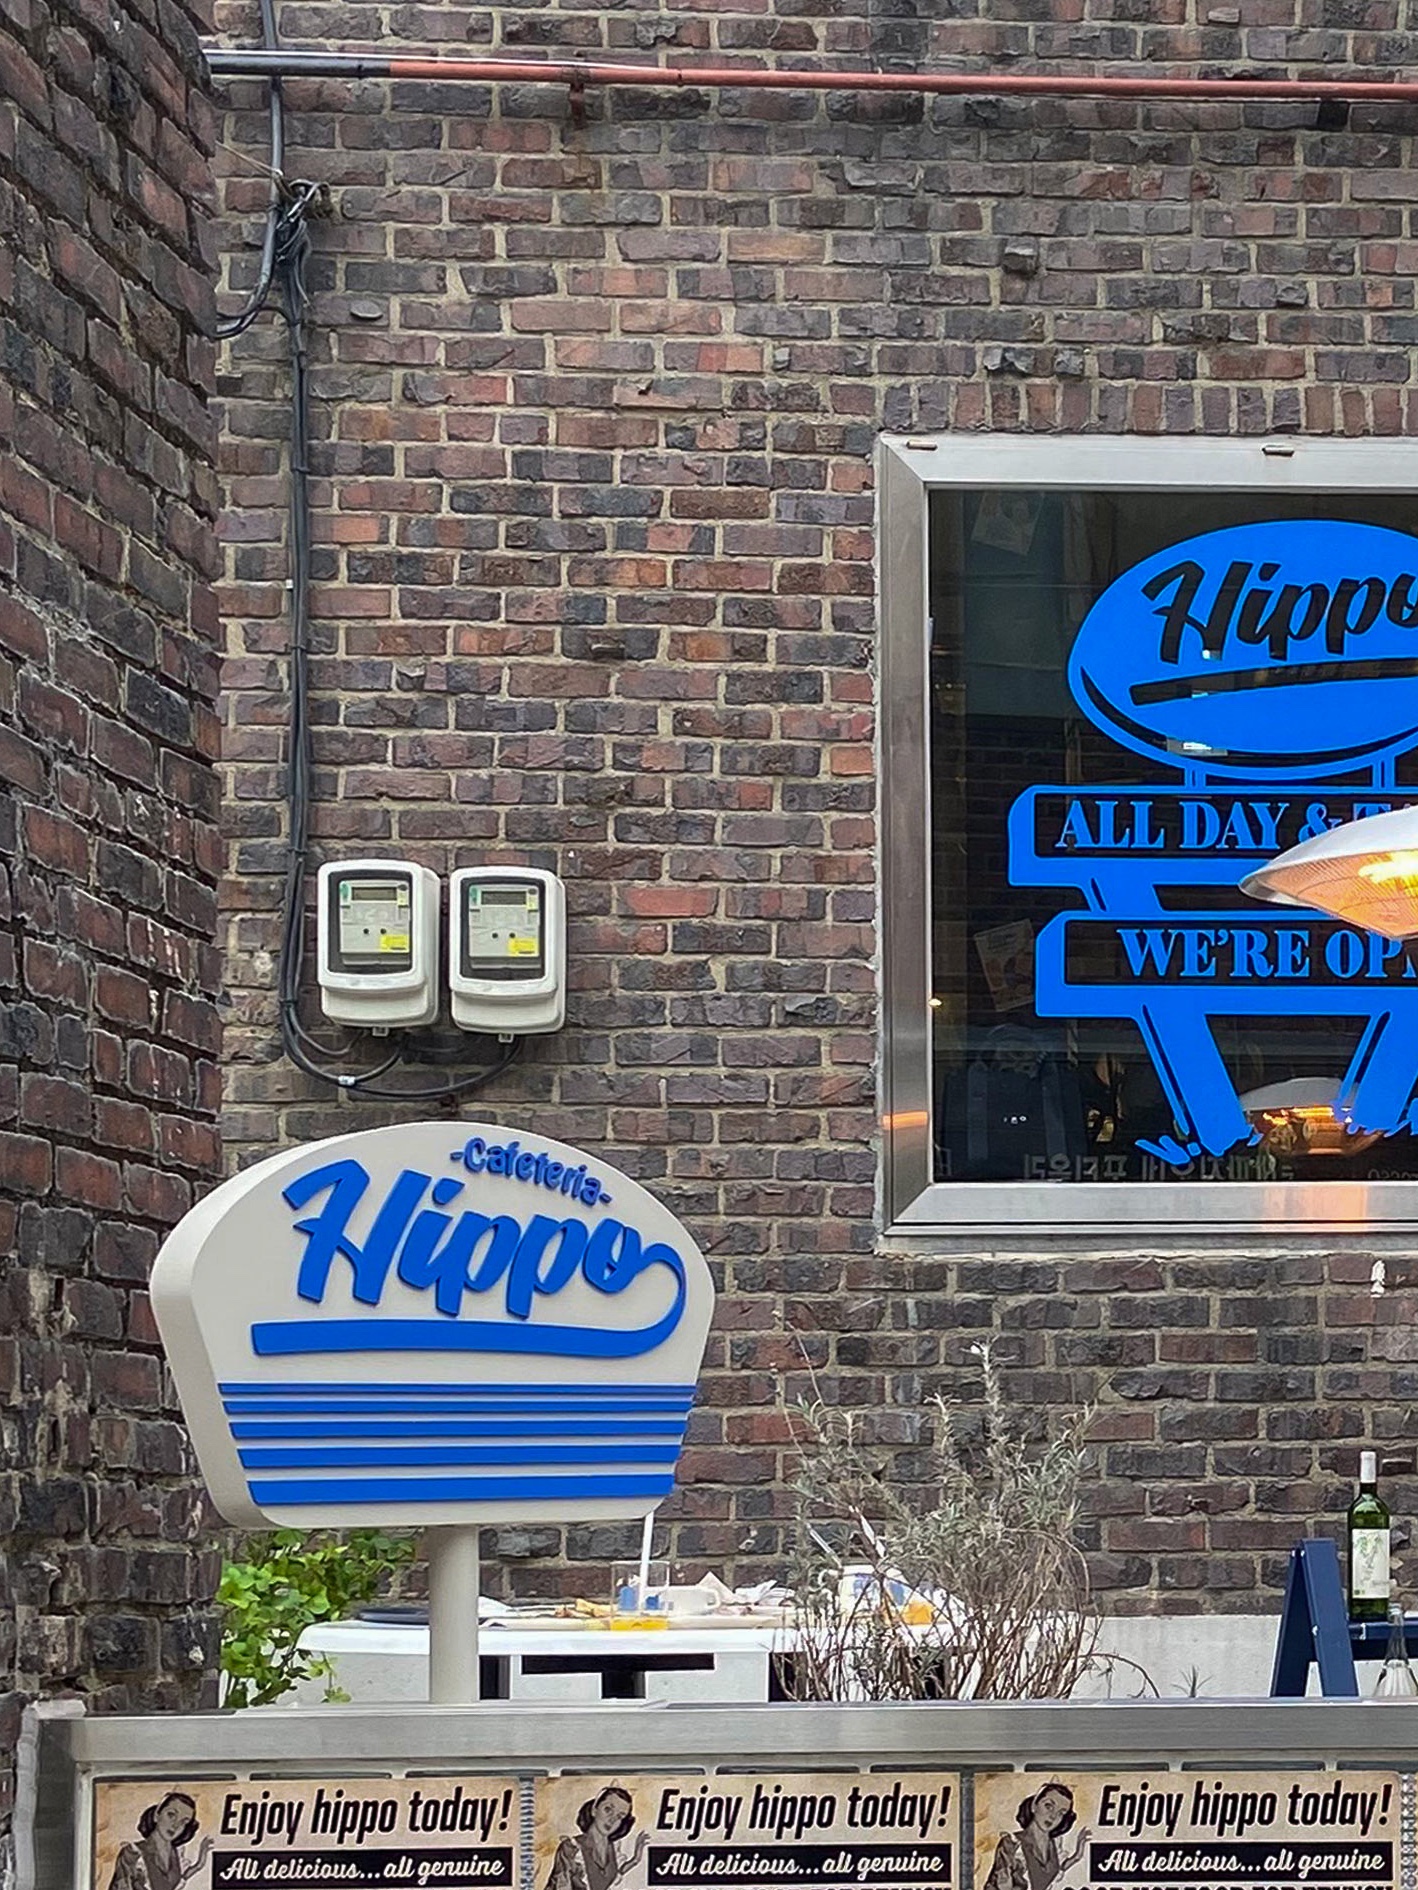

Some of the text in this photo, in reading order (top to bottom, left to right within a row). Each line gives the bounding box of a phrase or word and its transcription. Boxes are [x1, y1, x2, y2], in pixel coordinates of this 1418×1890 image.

[1055, 800, 1344, 849] ALL DAY &
[1117, 929, 1309, 978] WE'RE
[282, 1159, 687, 1320] Hippo
[220, 1785, 512, 1846] Enjoy hippo today!
[656, 1780, 951, 1841] Enjoy hippo today!
[1097, 1779, 1392, 1837] Enjoy hippo today!
[220, 1858, 260, 1880] All
[419, 1856, 505, 1885] genuine
[656, 1853, 696, 1875] All
[856, 1853, 944, 1881] genuine
[1098, 1849, 1139, 1872] All
[1298, 1849, 1385, 1879] genuine
